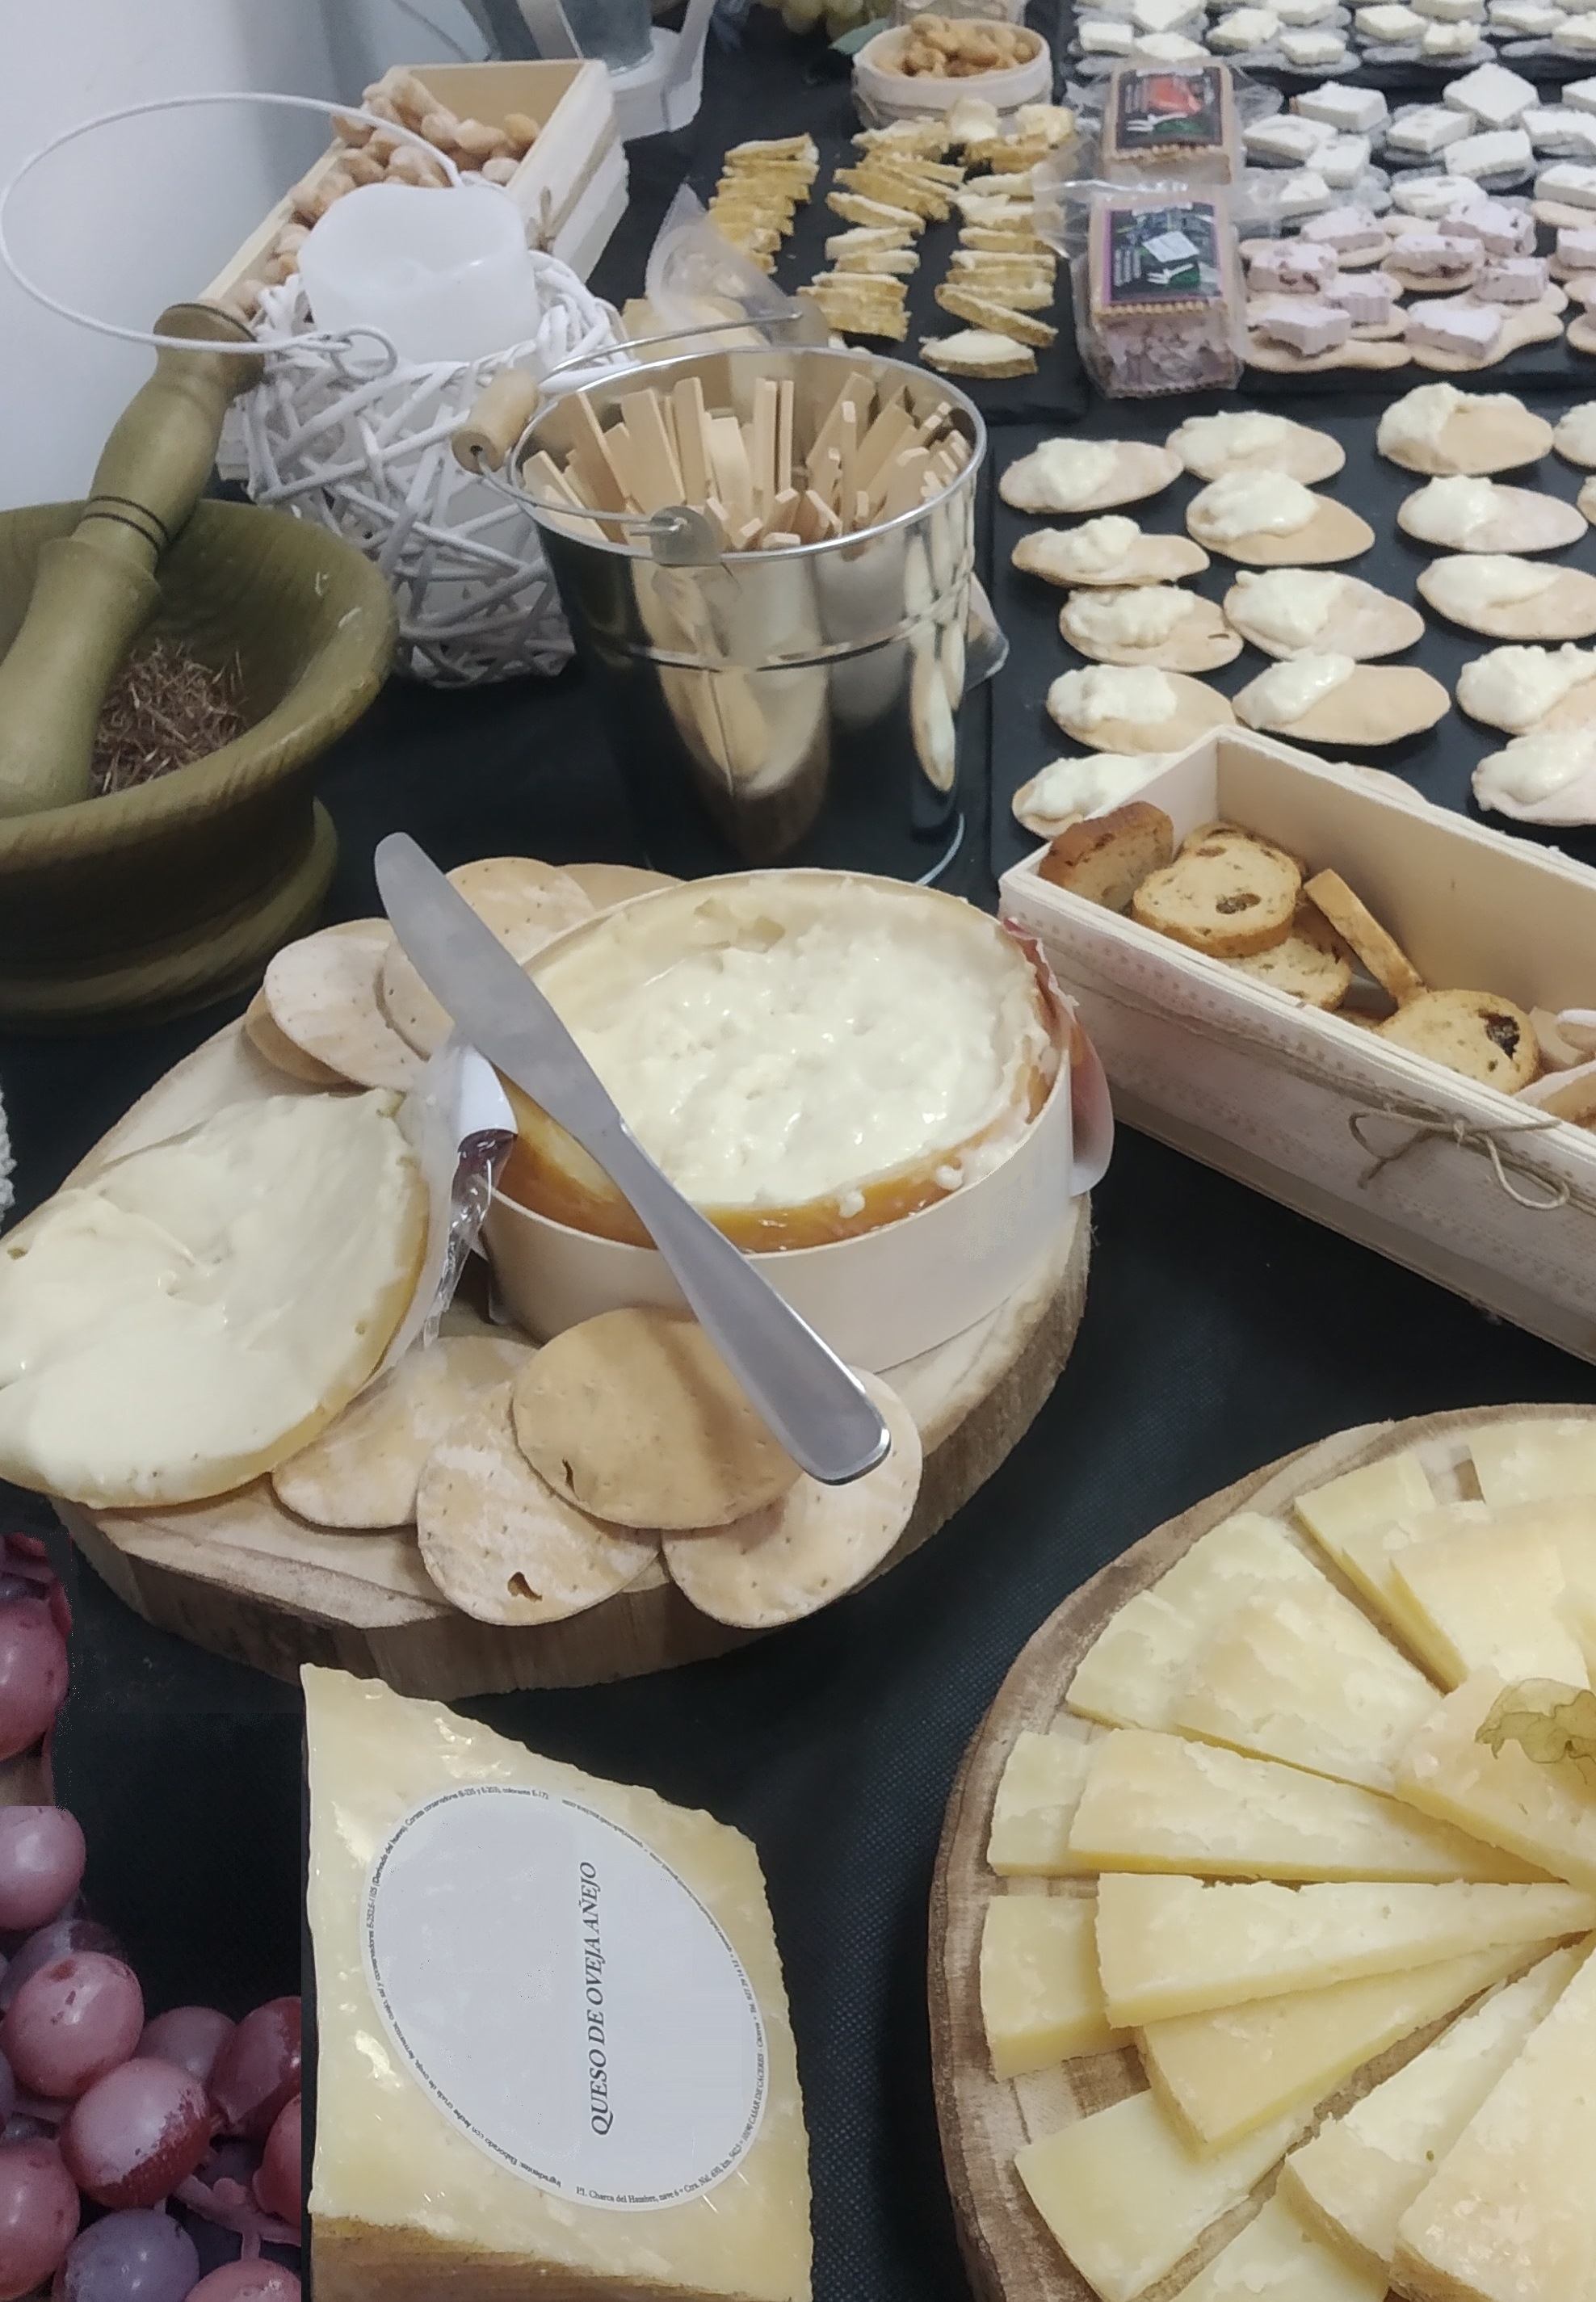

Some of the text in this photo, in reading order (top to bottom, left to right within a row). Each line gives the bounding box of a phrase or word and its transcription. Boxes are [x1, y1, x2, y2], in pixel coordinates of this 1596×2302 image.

[384, 1842, 393, 1855] del
[376, 1981, 384, 1989] y
[376, 1988, 386, 1997] sal
[578, 1862, 613, 2135] QUESO DE OVEJA AÑEJO
[428, 2079, 437, 2090] de
[436, 2090, 453, 2109] cruda
[452, 2108, 472, 2128] leche
[484, 2137, 518, 2165] Elaborado
[588, 2189, 614, 2202] Charca
[615, 2194, 627, 2203] del
[748, 2099, 760, 2124] CASAR
[754, 2087, 762, 2101] DE
